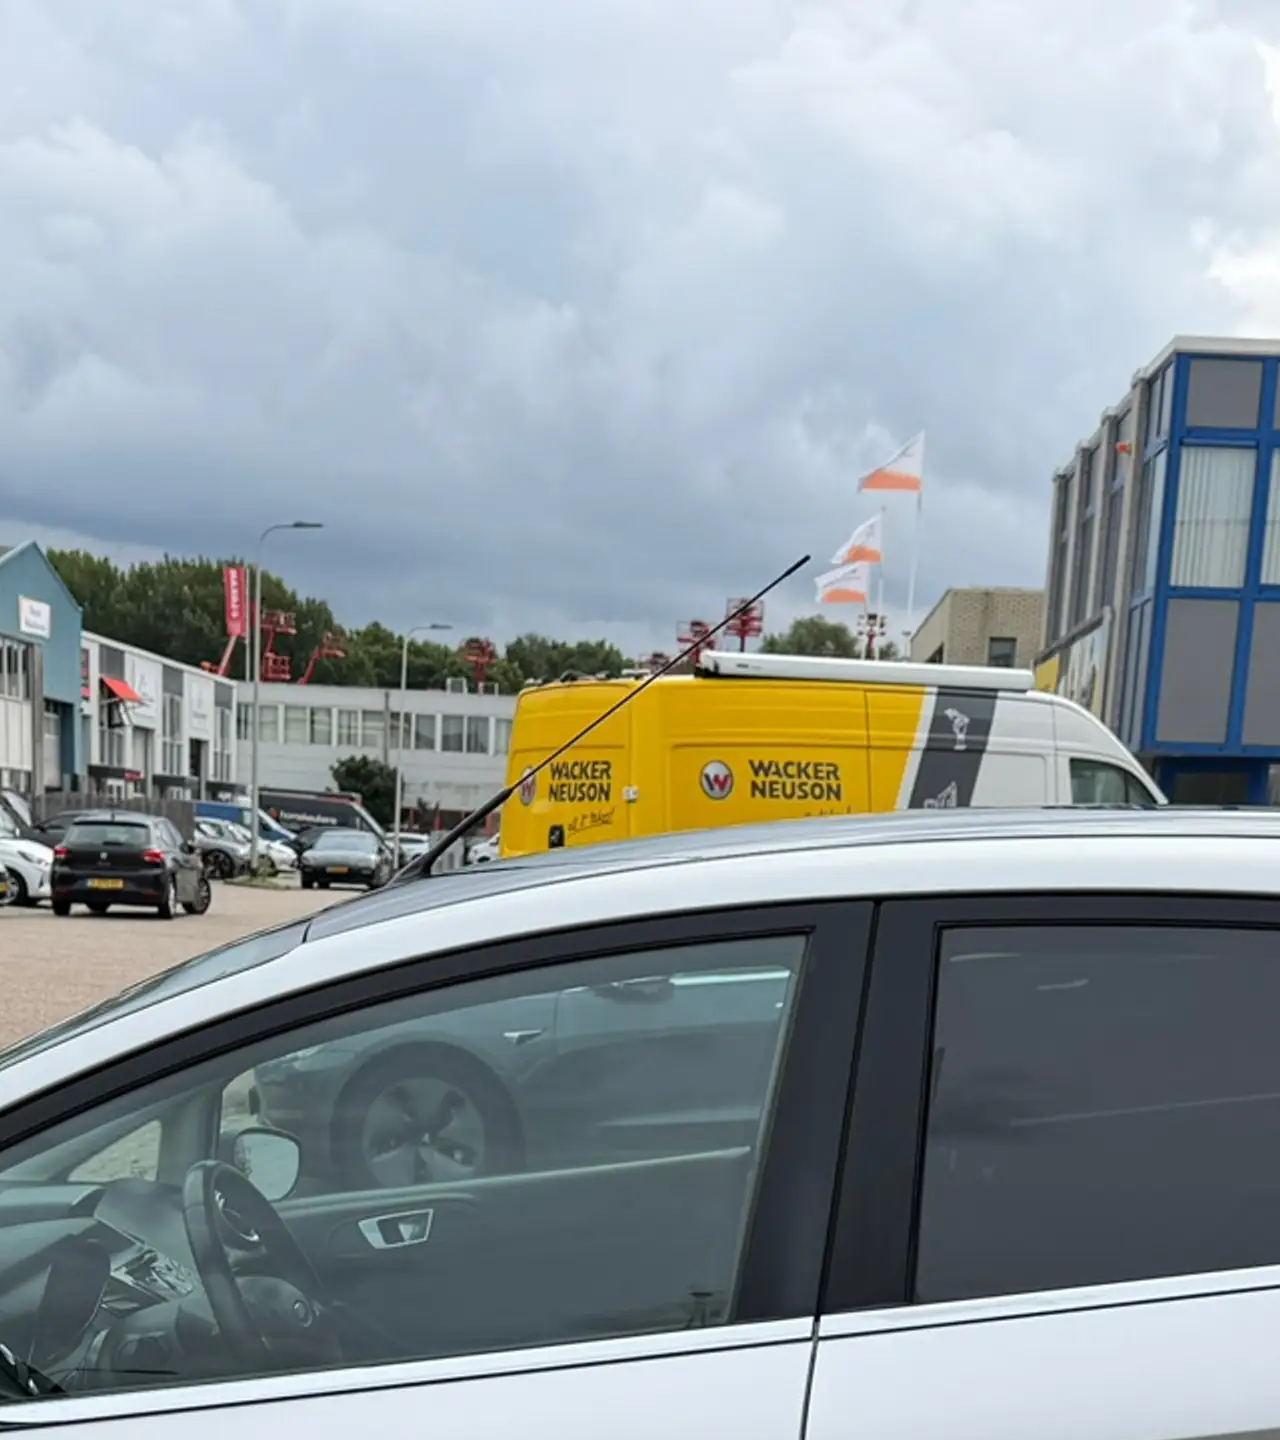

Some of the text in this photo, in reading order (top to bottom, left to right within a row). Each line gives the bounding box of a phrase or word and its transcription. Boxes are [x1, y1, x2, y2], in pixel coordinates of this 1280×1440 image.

[549, 760, 612, 781] WACKER
[748, 759, 841, 781] WACKER
[548, 782, 612, 803] NEUSON
[750, 779, 842, 802] NEUSON
